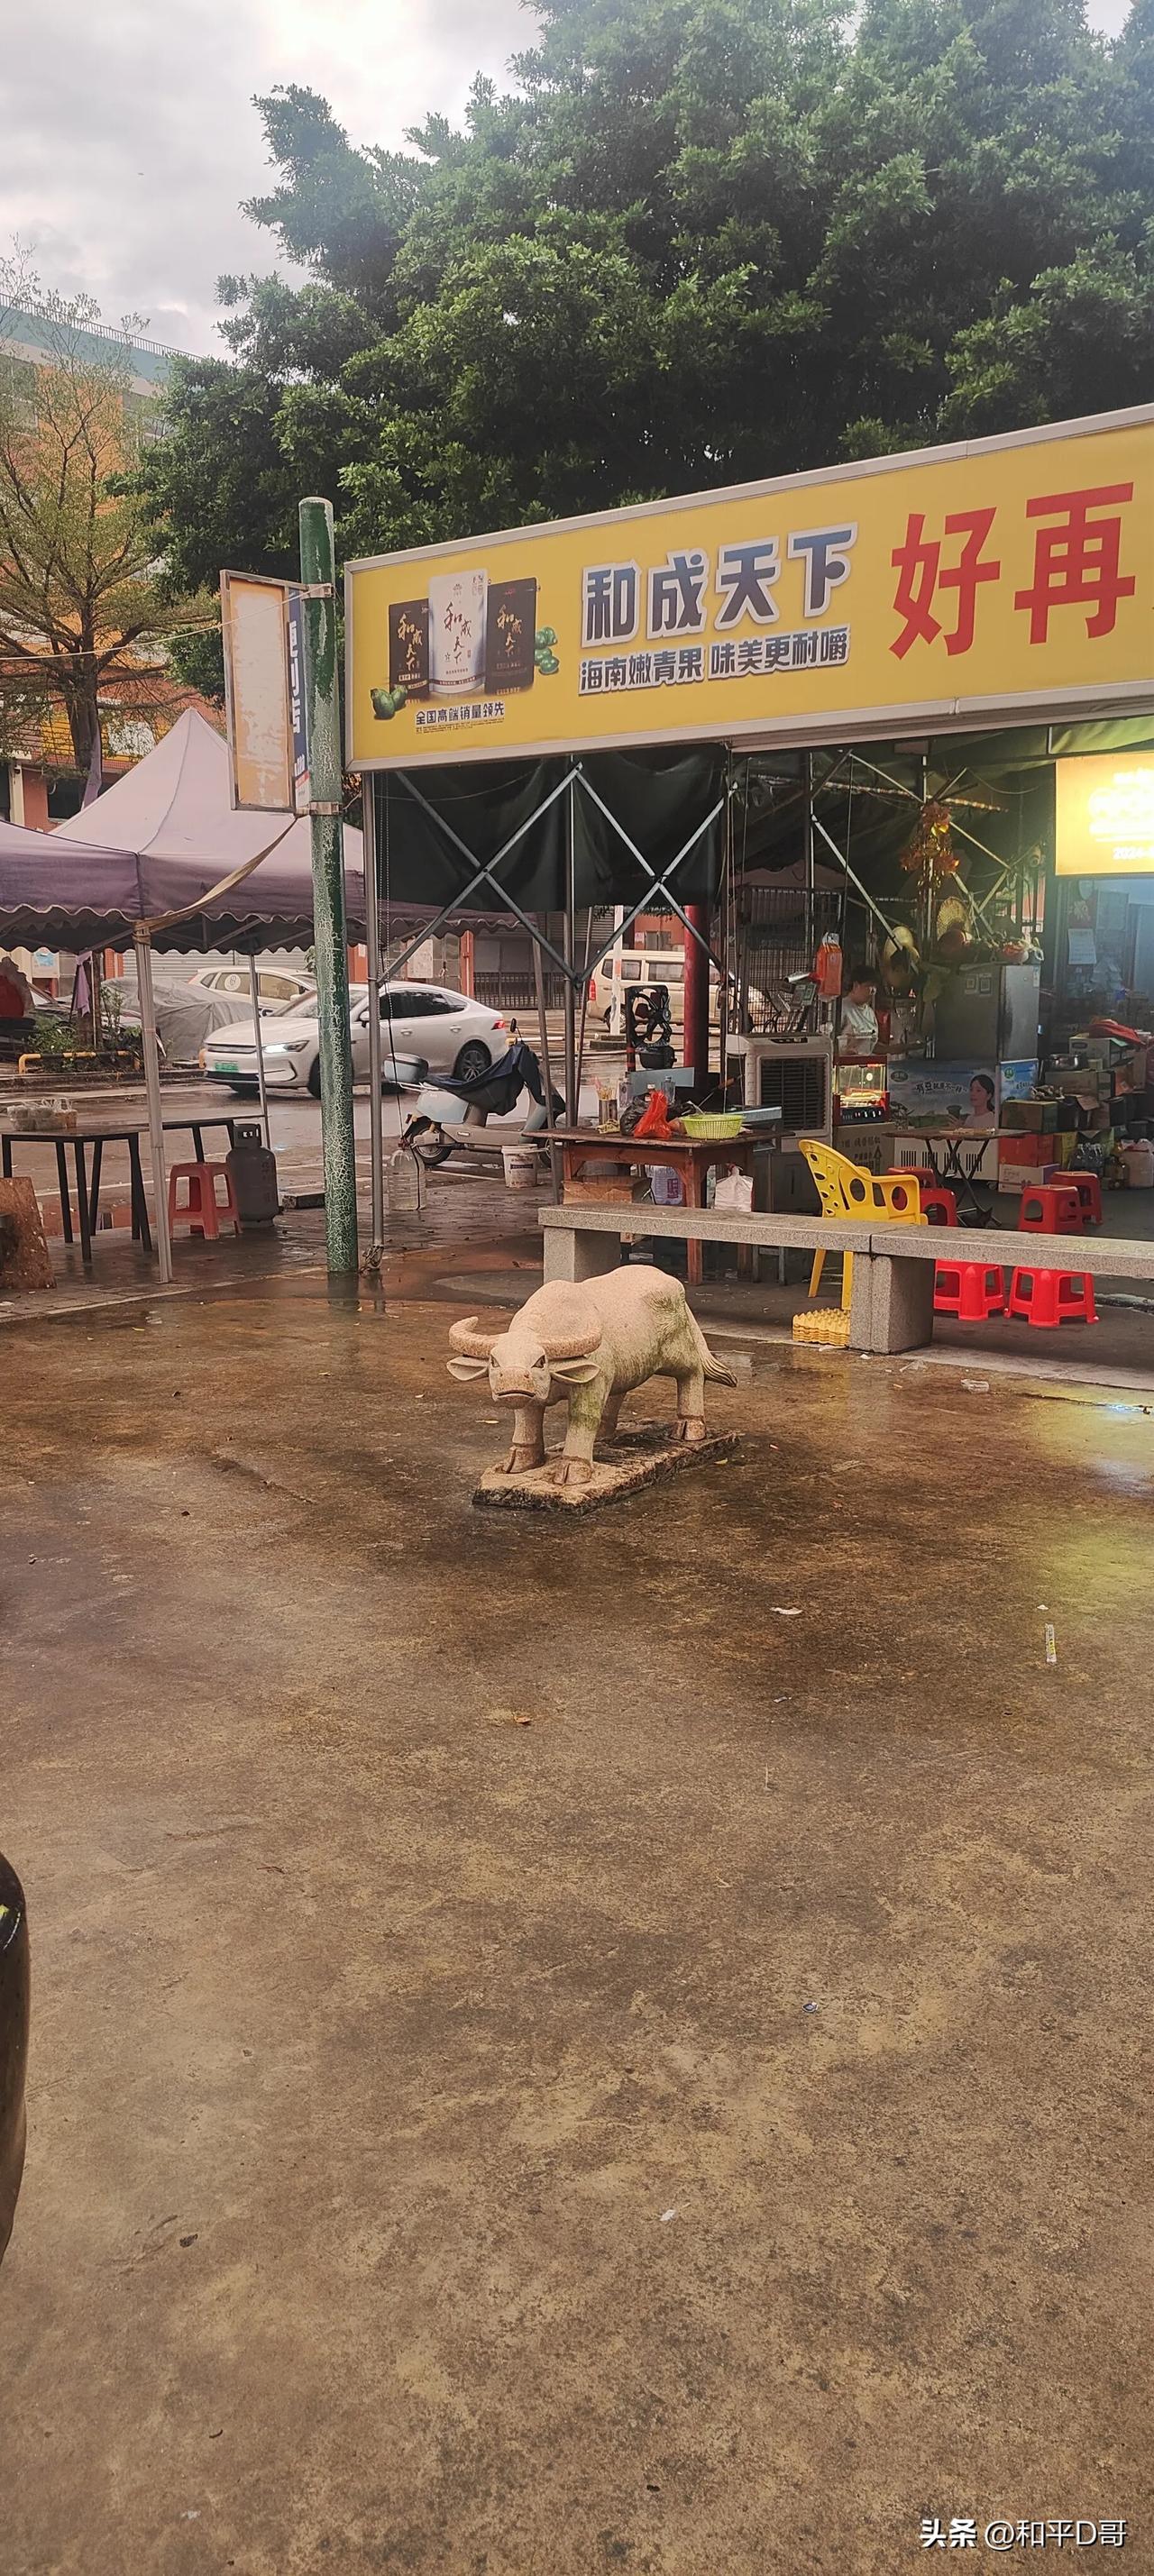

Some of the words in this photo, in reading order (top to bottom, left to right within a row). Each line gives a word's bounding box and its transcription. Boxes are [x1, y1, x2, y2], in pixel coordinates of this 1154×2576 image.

[584, 525, 855, 644] 和成天下
[889, 482, 1136, 660] 好再
[581, 646, 703, 691] 海南嫩青果
[710, 627, 848, 675] 味美更耐嚼
[416, 702, 505, 726] 全国高端销量领先
